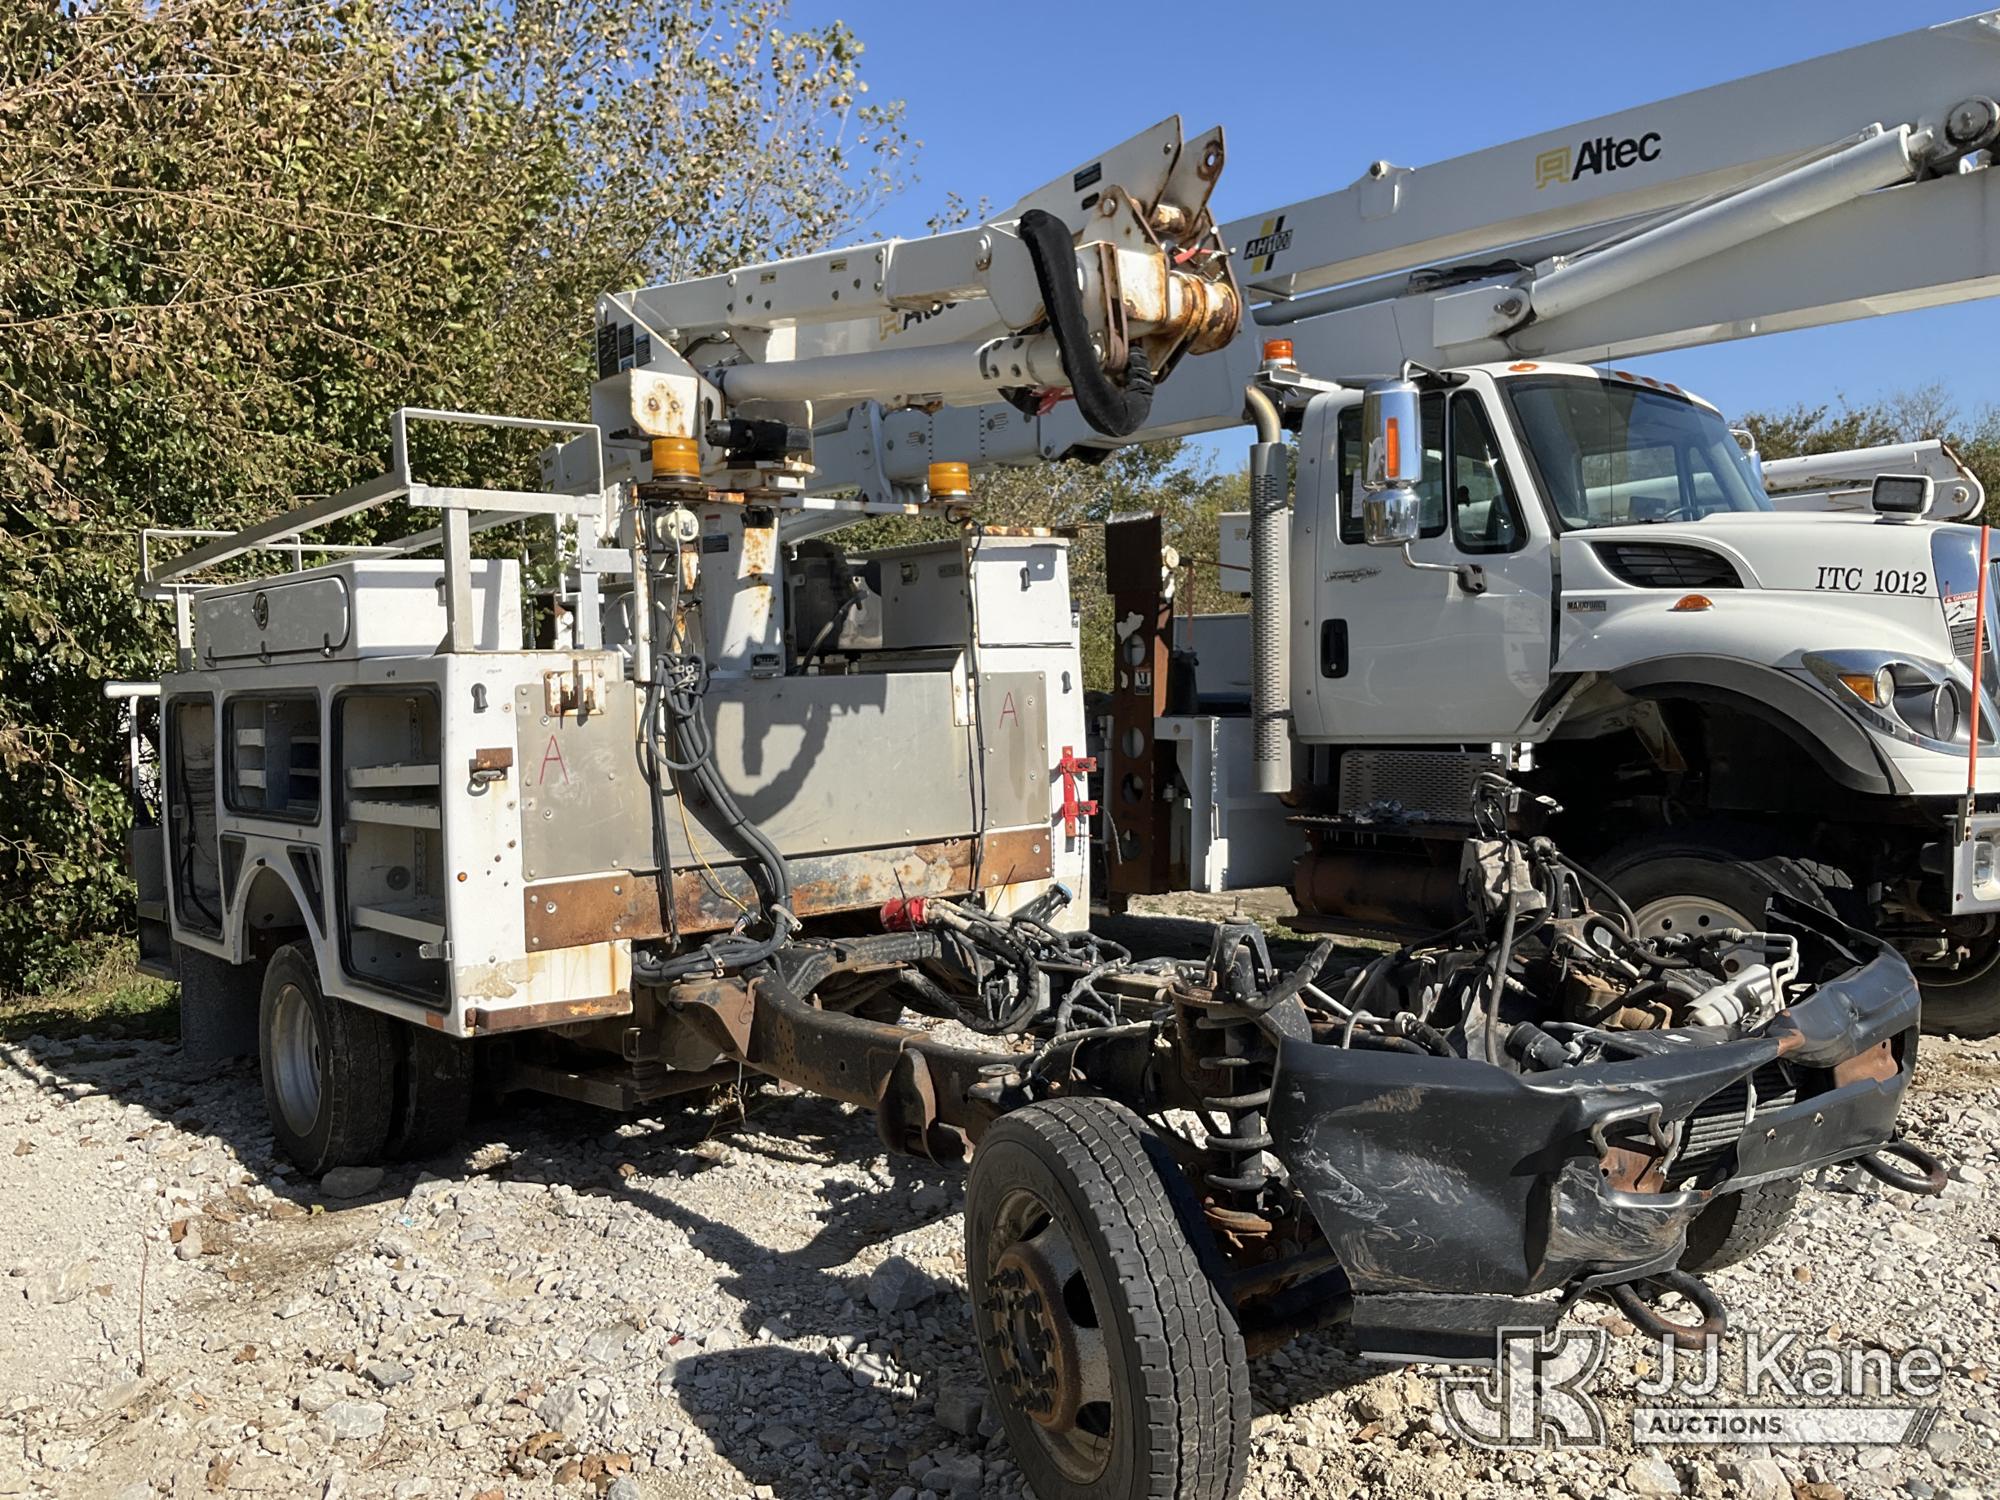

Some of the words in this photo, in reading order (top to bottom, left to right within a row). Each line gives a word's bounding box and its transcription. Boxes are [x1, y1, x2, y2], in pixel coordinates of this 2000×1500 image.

[1571, 132, 1662, 181] Altec
[1815, 566, 1863, 591] ITC
[1873, 569, 1928, 595] 1012
[999, 691, 1019, 729] A
[539, 734, 569, 785] A
